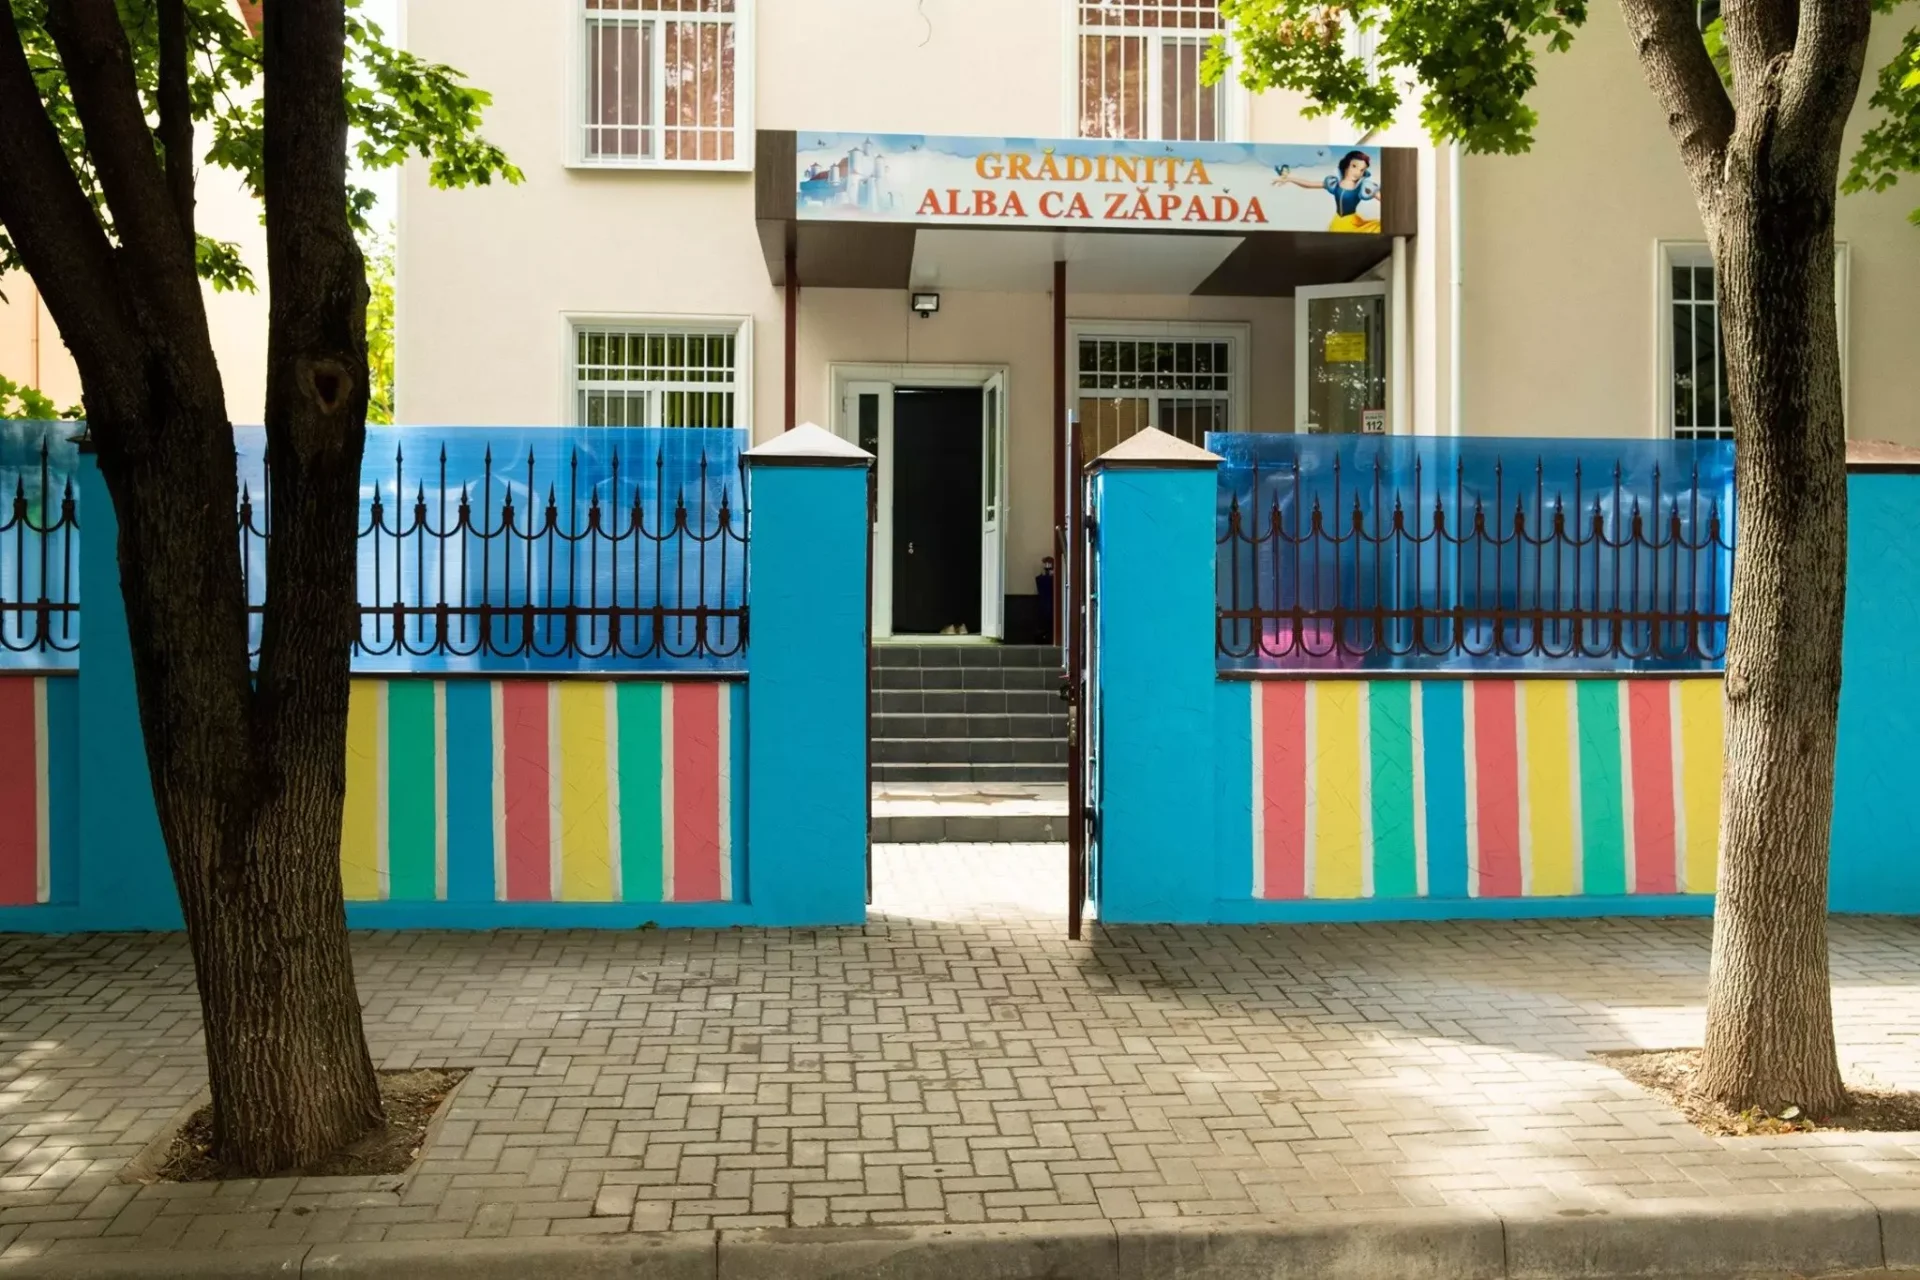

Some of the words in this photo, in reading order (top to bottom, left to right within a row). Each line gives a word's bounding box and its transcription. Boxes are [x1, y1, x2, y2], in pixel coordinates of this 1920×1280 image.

[915, 188, 1028, 218] ALBA
[1038, 191, 1094, 219] CA
[1103, 186, 1269, 224] ZĂPADA
[1366, 420, 1383, 431] 112
